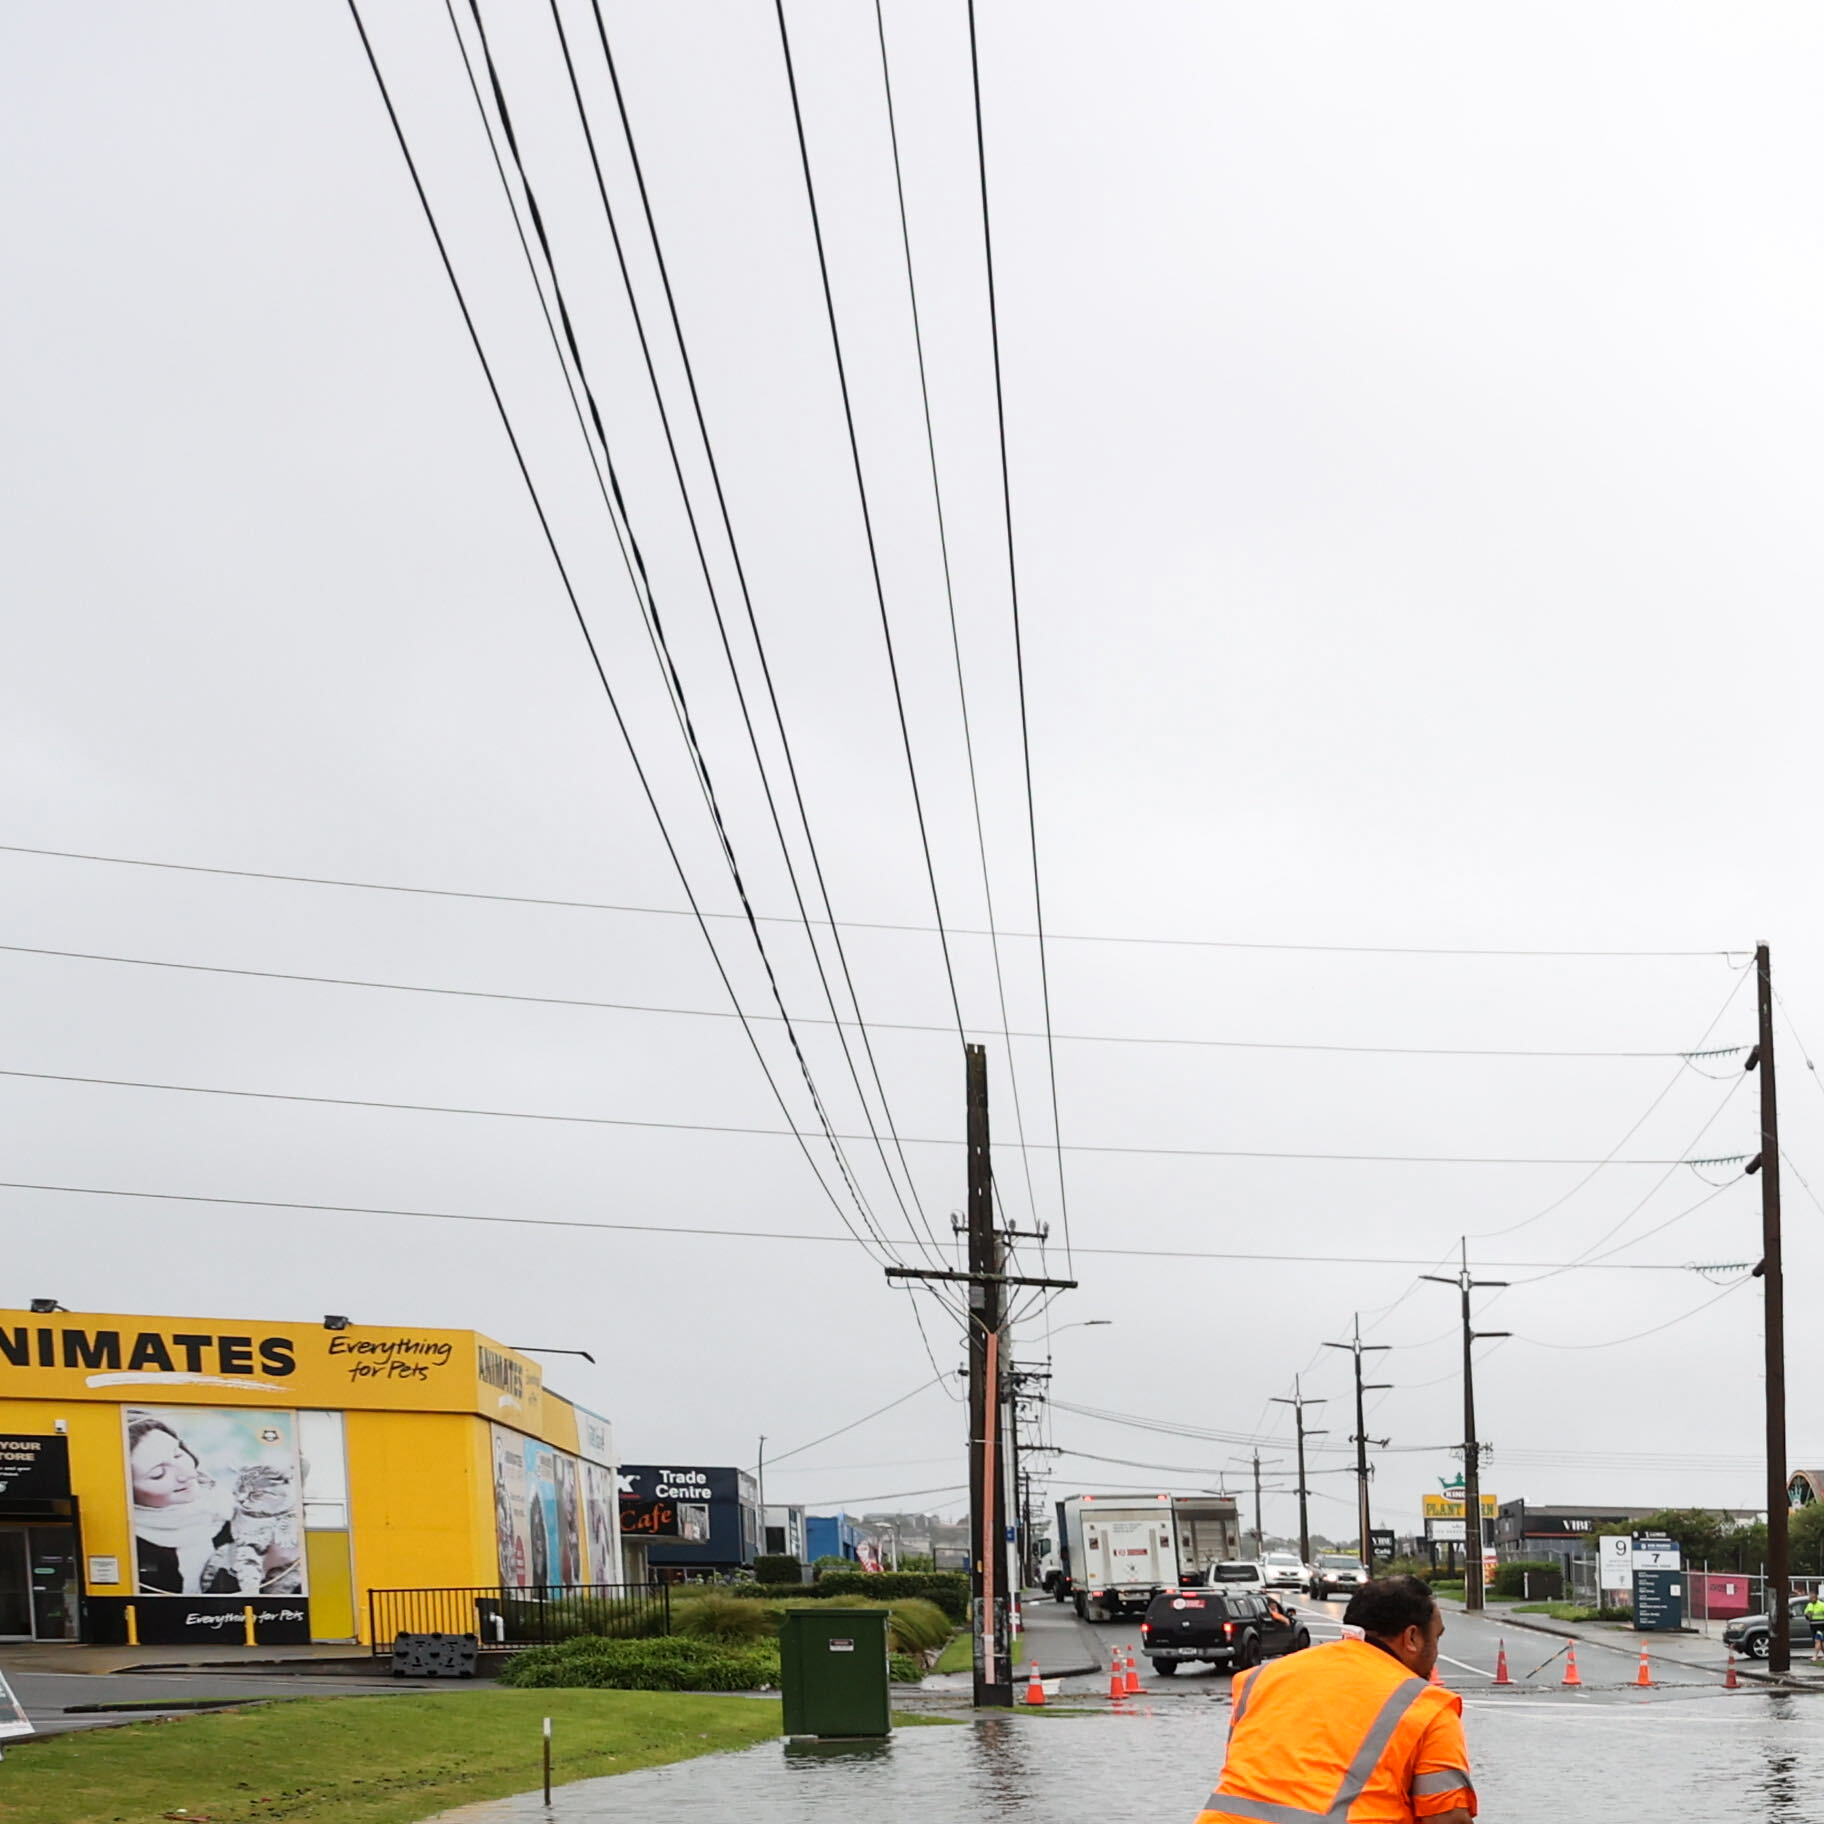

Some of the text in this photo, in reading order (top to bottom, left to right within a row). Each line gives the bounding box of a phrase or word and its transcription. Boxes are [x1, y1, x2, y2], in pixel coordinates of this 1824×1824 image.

[328, 1336, 452, 1366] Everything
[348, 1360, 429, 1382] for Pets
[0, 1441, 41, 1450] YOUR
[659, 1470, 707, 1484] Trade
[655, 1484, 712, 1499] Centre
[1426, 1504, 1461, 1516] PLANT
[1562, 1520, 1592, 1531] VIBE
[1615, 1540, 1627, 1556] 9
[1652, 1553, 1660, 1563] 7
[185, 1609, 304, 1629] Everythin for Pets
